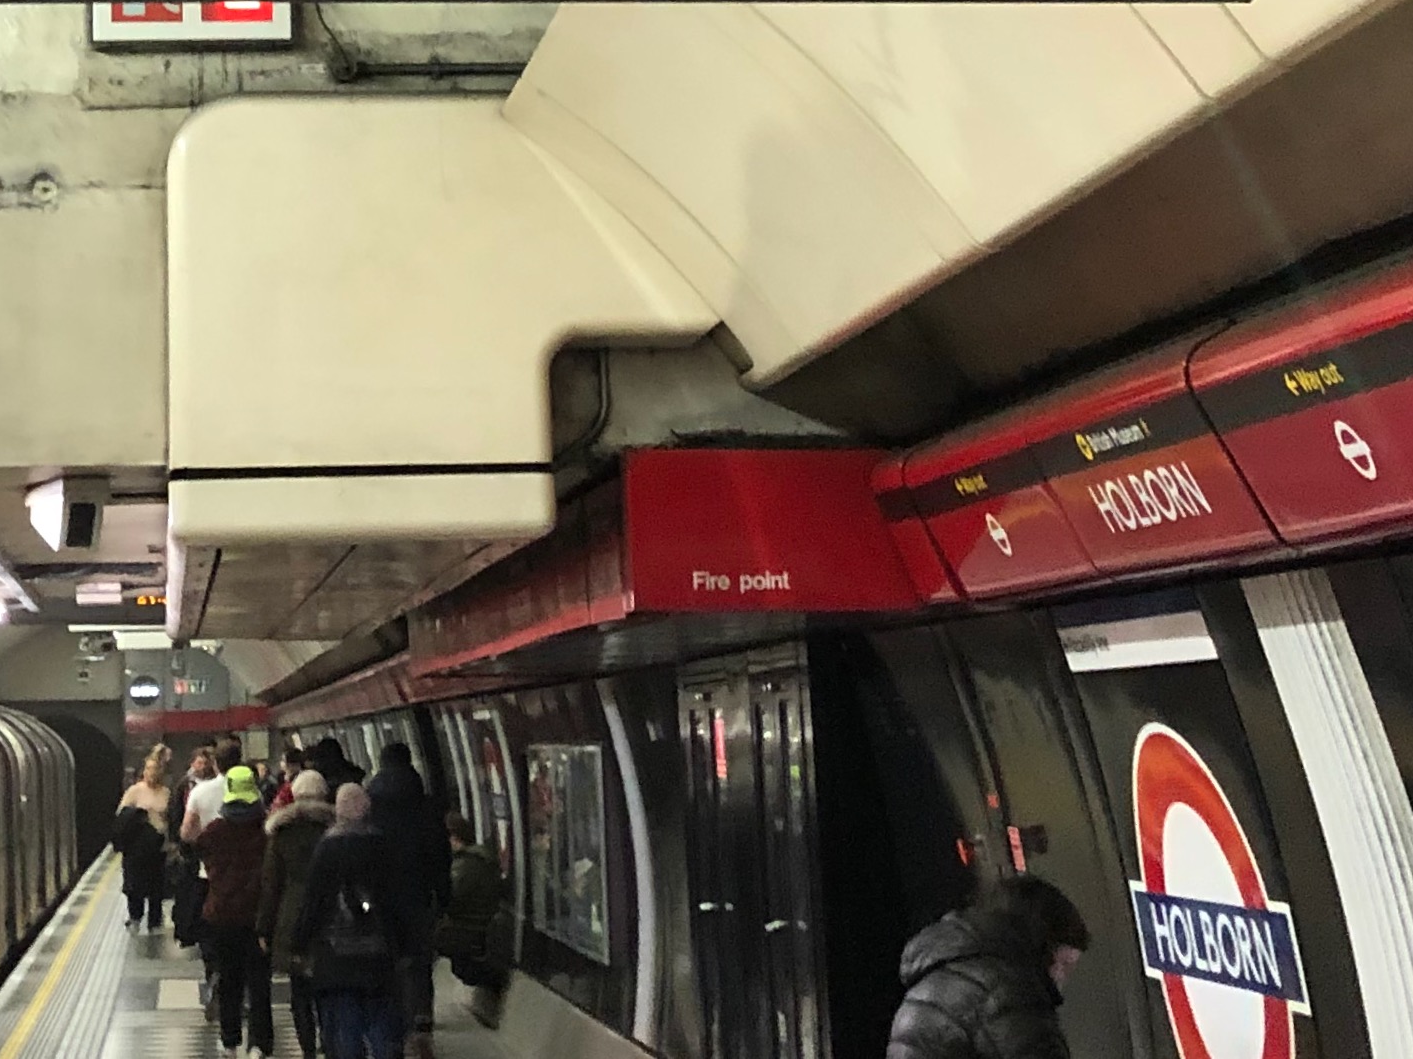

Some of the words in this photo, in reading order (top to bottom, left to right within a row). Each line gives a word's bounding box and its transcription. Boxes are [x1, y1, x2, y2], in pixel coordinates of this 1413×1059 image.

[1292, 368, 1325, 395] Way
[1319, 361, 1344, 386] out
[1088, 460, 1213, 534] HOLBORN
[692, 570, 731, 591] Fire
[739, 569, 791, 595] point
[1149, 901, 1283, 990] HOLBORN
